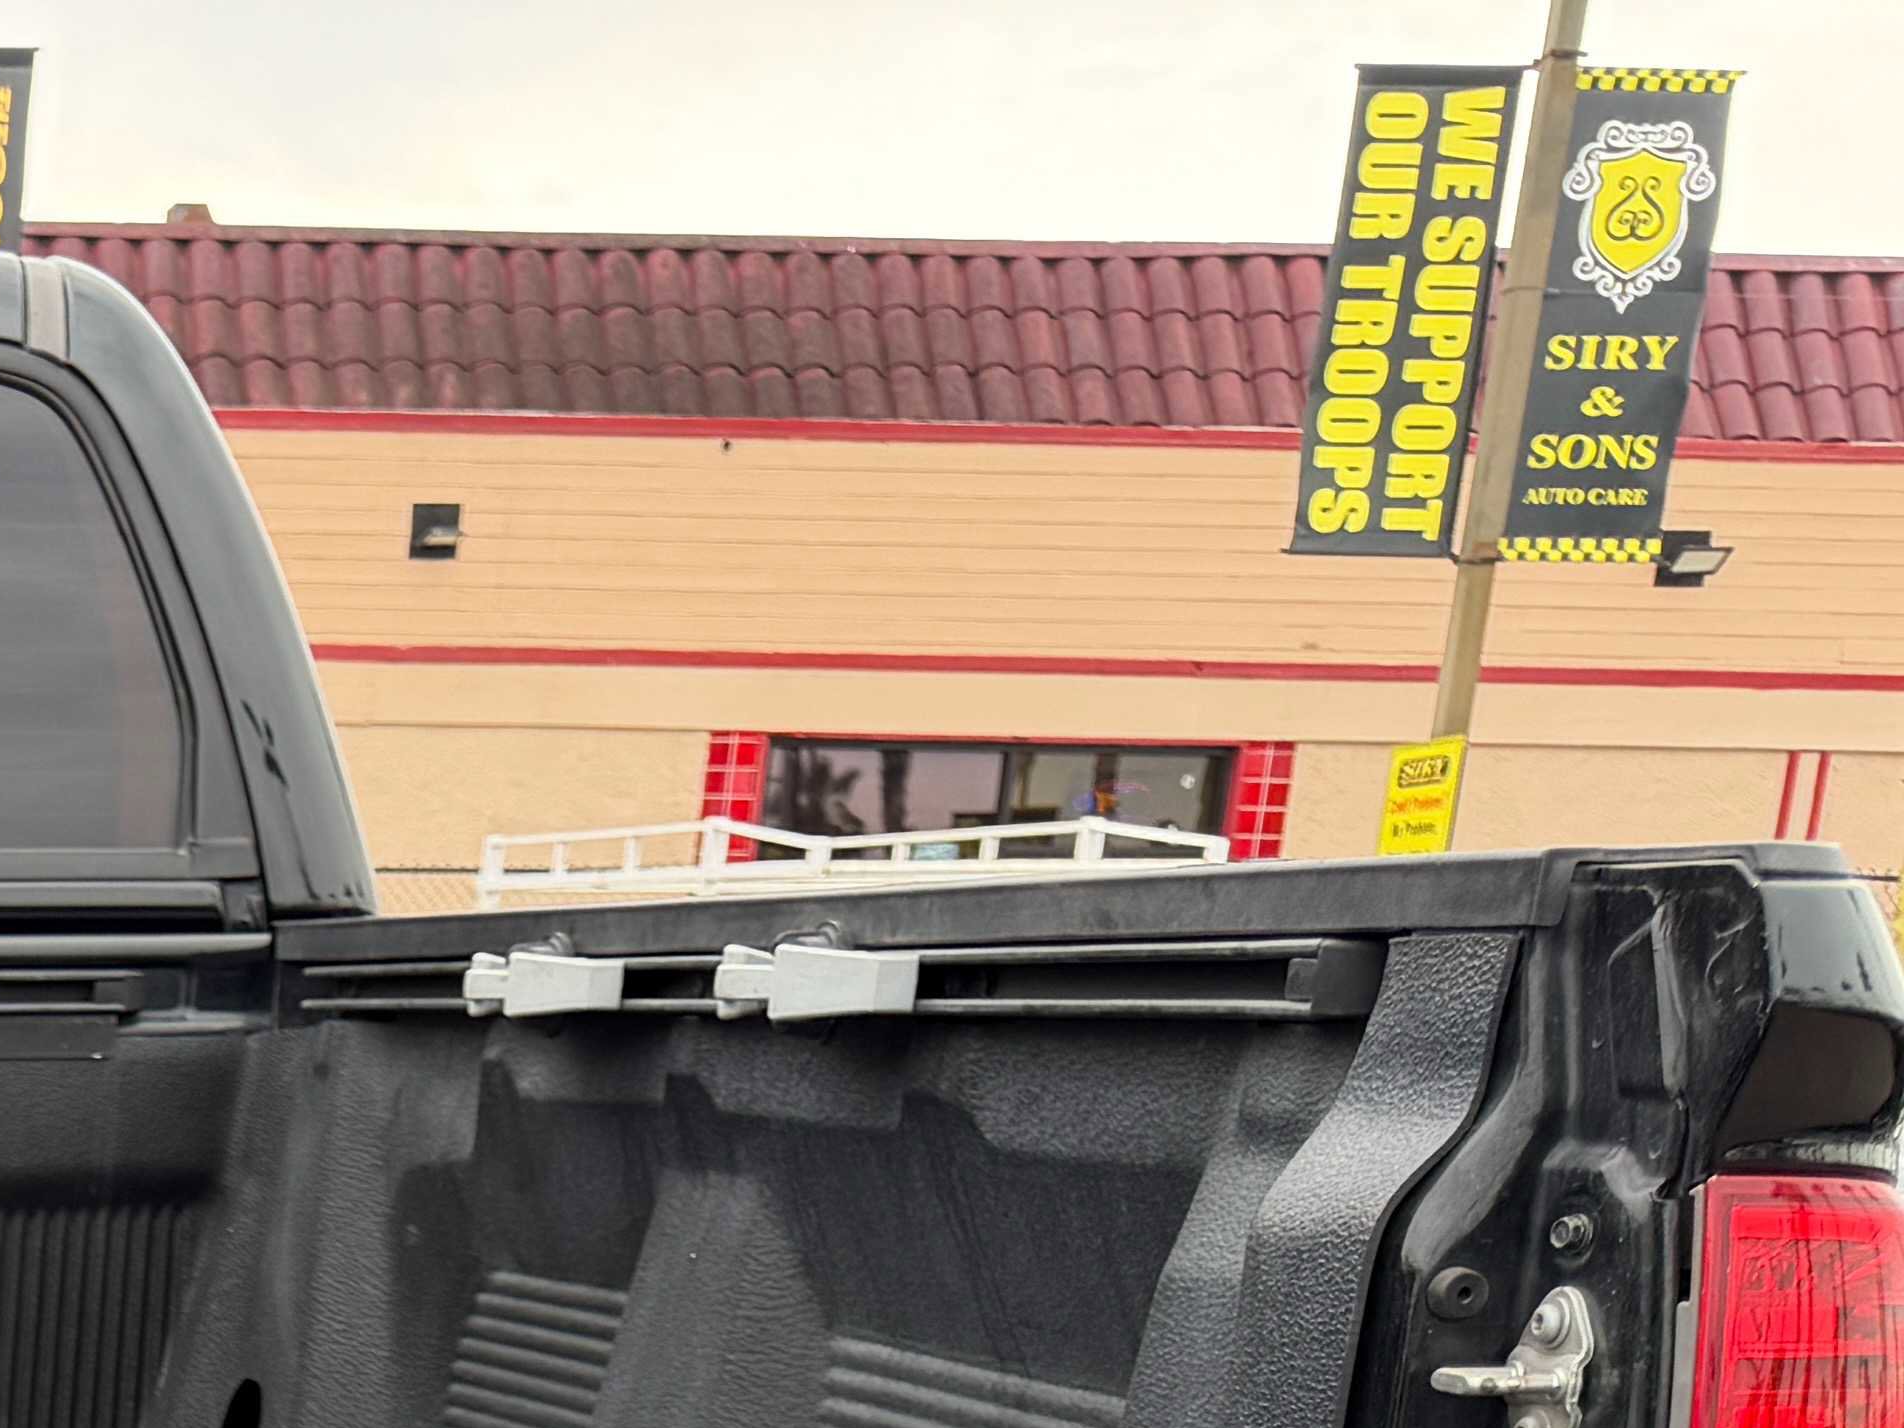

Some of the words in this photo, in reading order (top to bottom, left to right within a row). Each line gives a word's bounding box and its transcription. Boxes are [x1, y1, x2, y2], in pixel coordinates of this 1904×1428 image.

[1348, 91, 1430, 241] OUR
[1432, 86, 1506, 201] WE
[1380, 216, 1488, 541] SUPPORT
[1544, 334, 1680, 371] SIRY
[1307, 255, 1406, 535] TROOPS
[1580, 386, 1625, 417] &
[1526, 433, 1660, 471] SONS
[1522, 487, 1585, 505] AUTO
[1586, 487, 1649, 506] CARE
